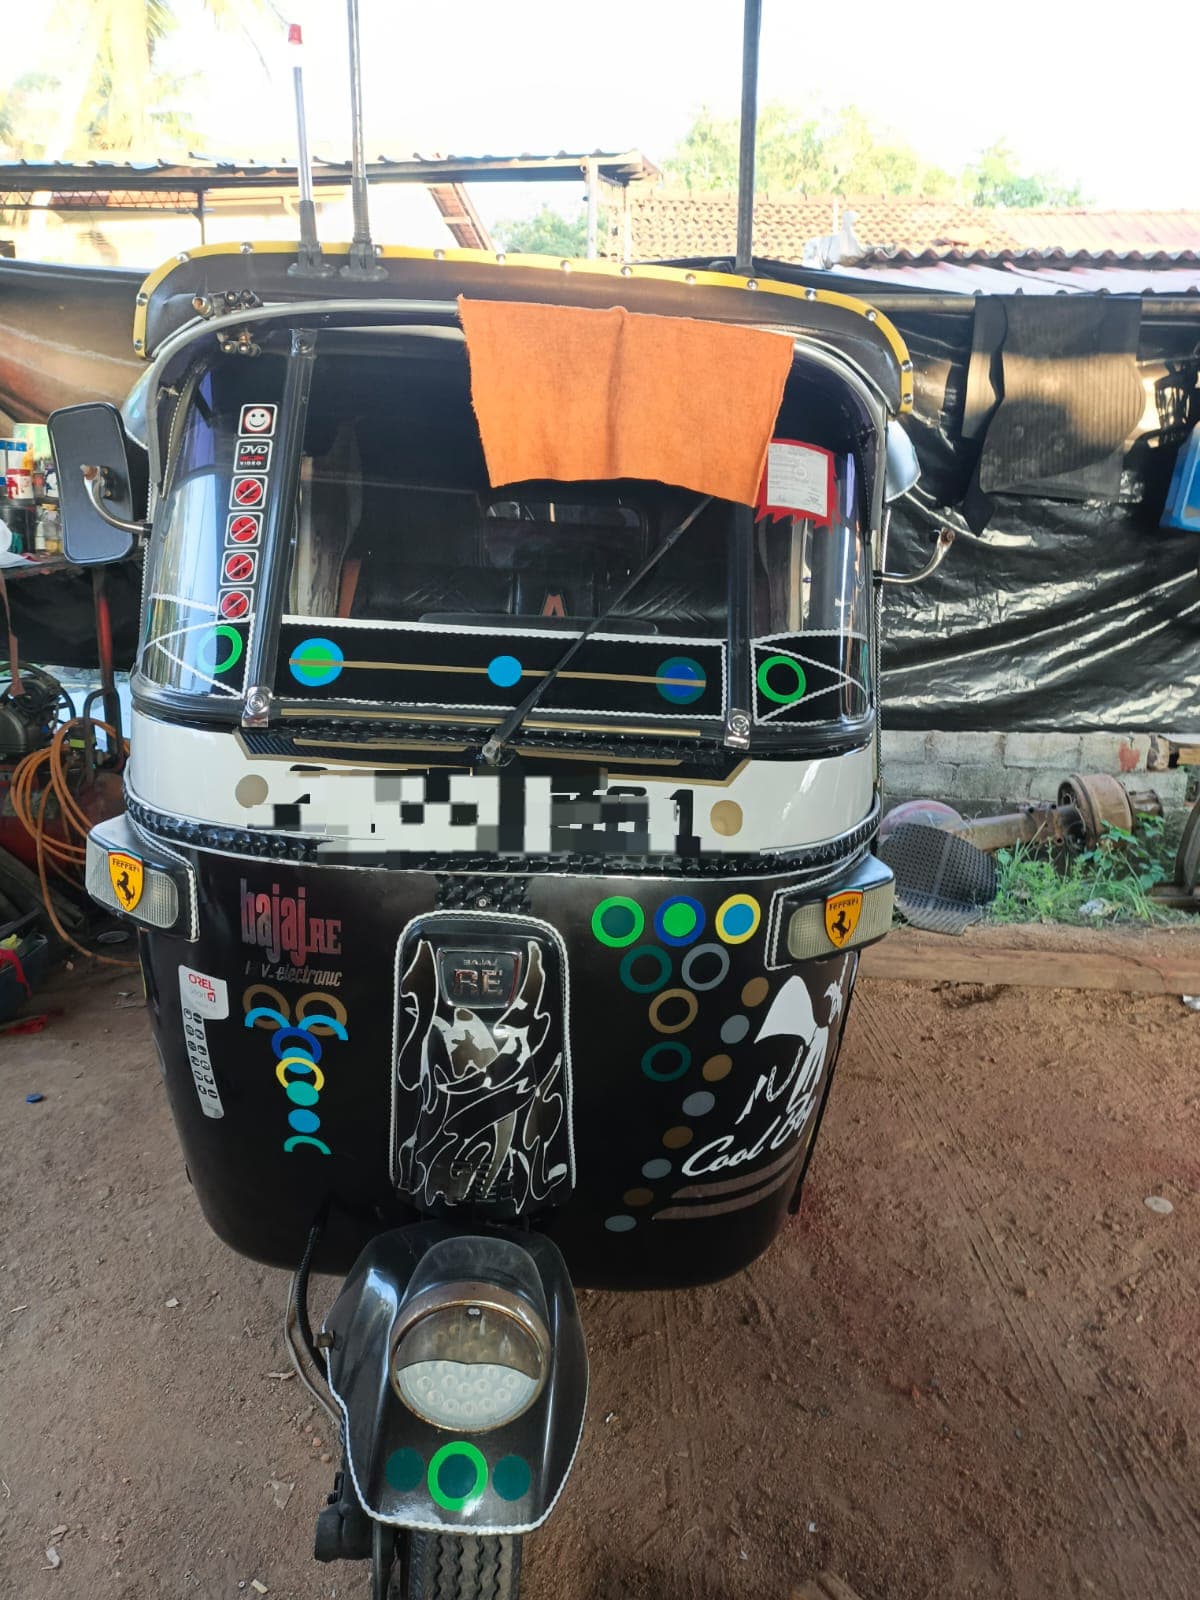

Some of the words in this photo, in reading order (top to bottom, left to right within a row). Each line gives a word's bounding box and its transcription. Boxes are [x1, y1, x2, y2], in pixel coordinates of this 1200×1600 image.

[240, 445, 268, 454] DVD
[112, 858, 140, 872] Ferrari
[240, 878, 306, 967] bajaj
[305, 917, 342, 955] RE
[188, 973, 216, 991] OREL
[454, 969, 503, 993] RE
[681, 1115, 782, 1177] Cool
